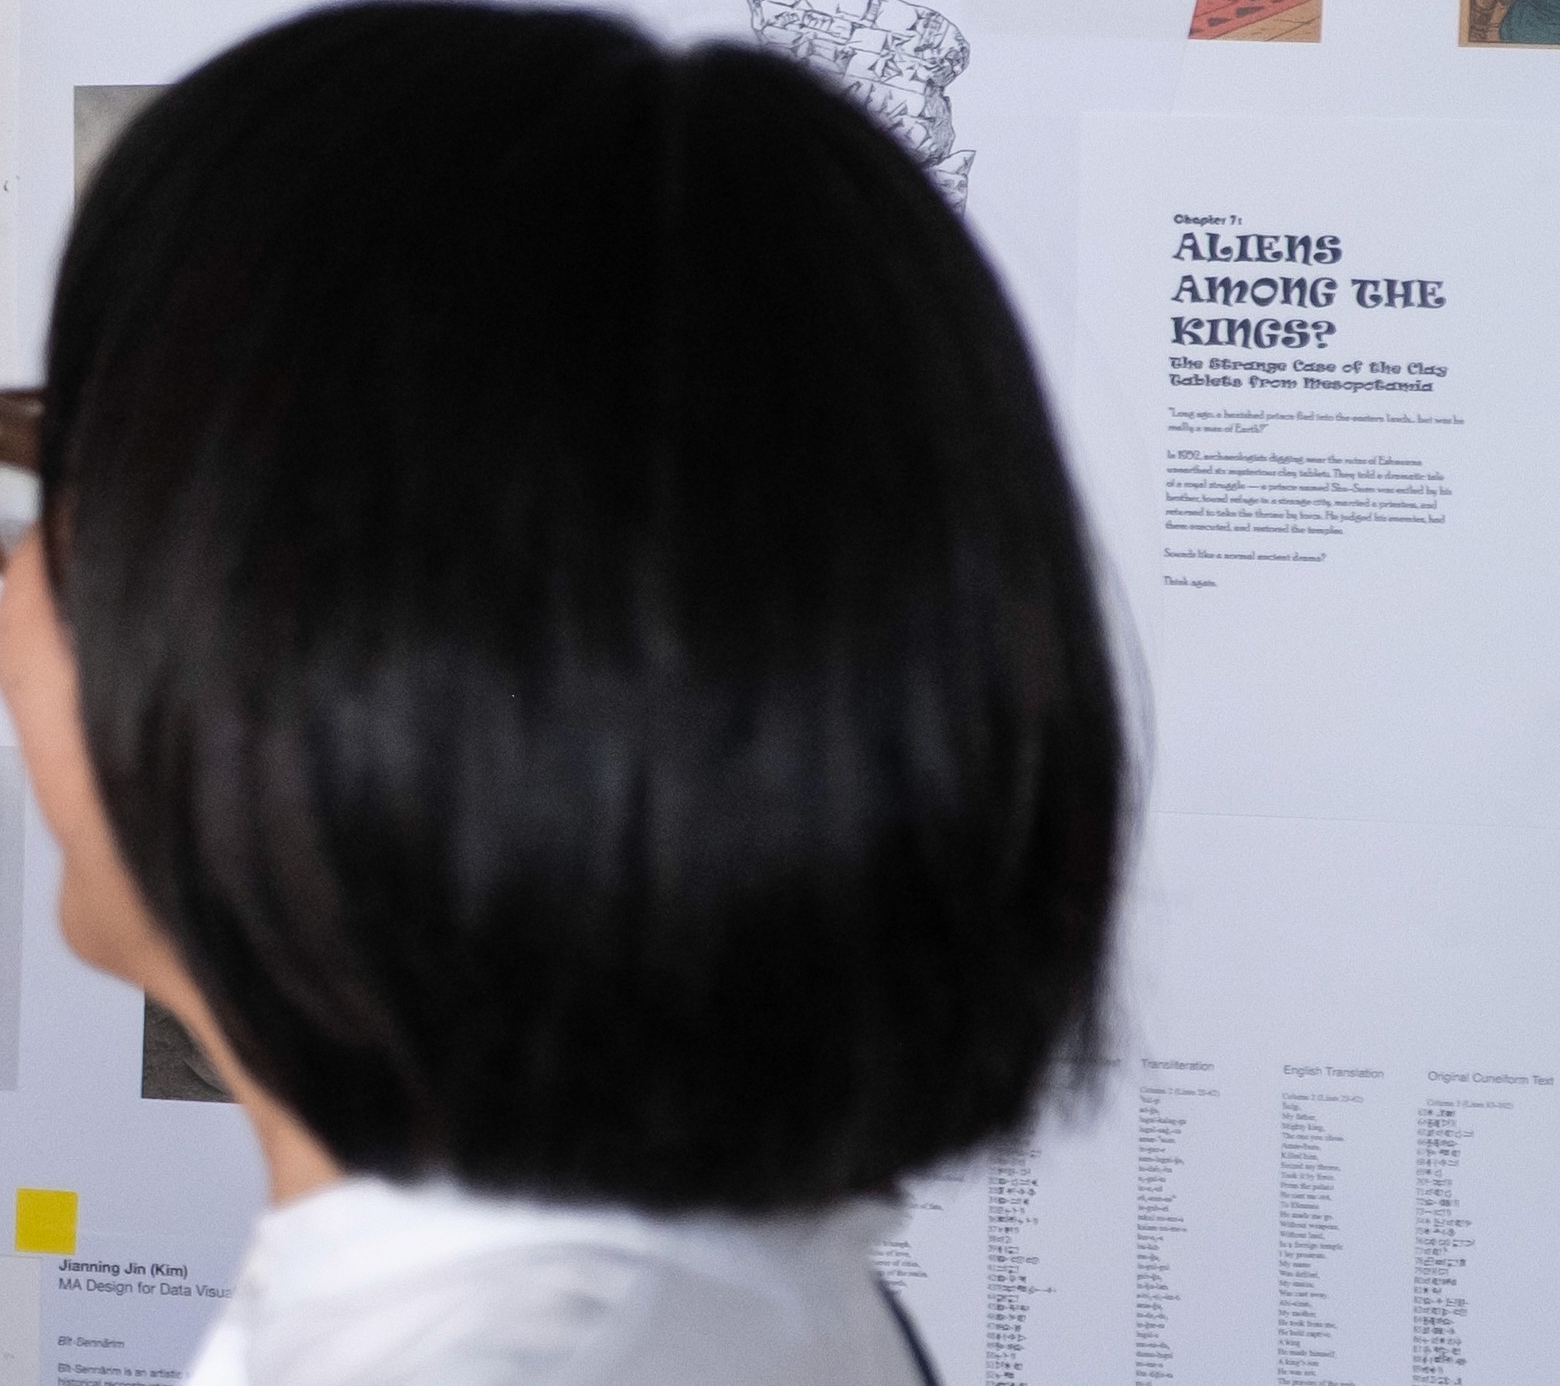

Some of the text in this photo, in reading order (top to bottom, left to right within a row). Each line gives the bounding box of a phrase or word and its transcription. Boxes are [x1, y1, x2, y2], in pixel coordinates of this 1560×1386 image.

[1172, 232, 1341, 265] ALIENS
[1172, 274, 1446, 308] AMONG THE
[1171, 317, 1336, 349] KINGS?
[1169, 356, 1448, 378] The Strange Case of the Clay
[124, 1262, 146, 1275] Jin
[59, 1277, 82, 1290] MA
[86, 1278, 133, 1296] Design
[138, 1281, 156, 1294] for
[160, 1282, 192, 1296] Data
